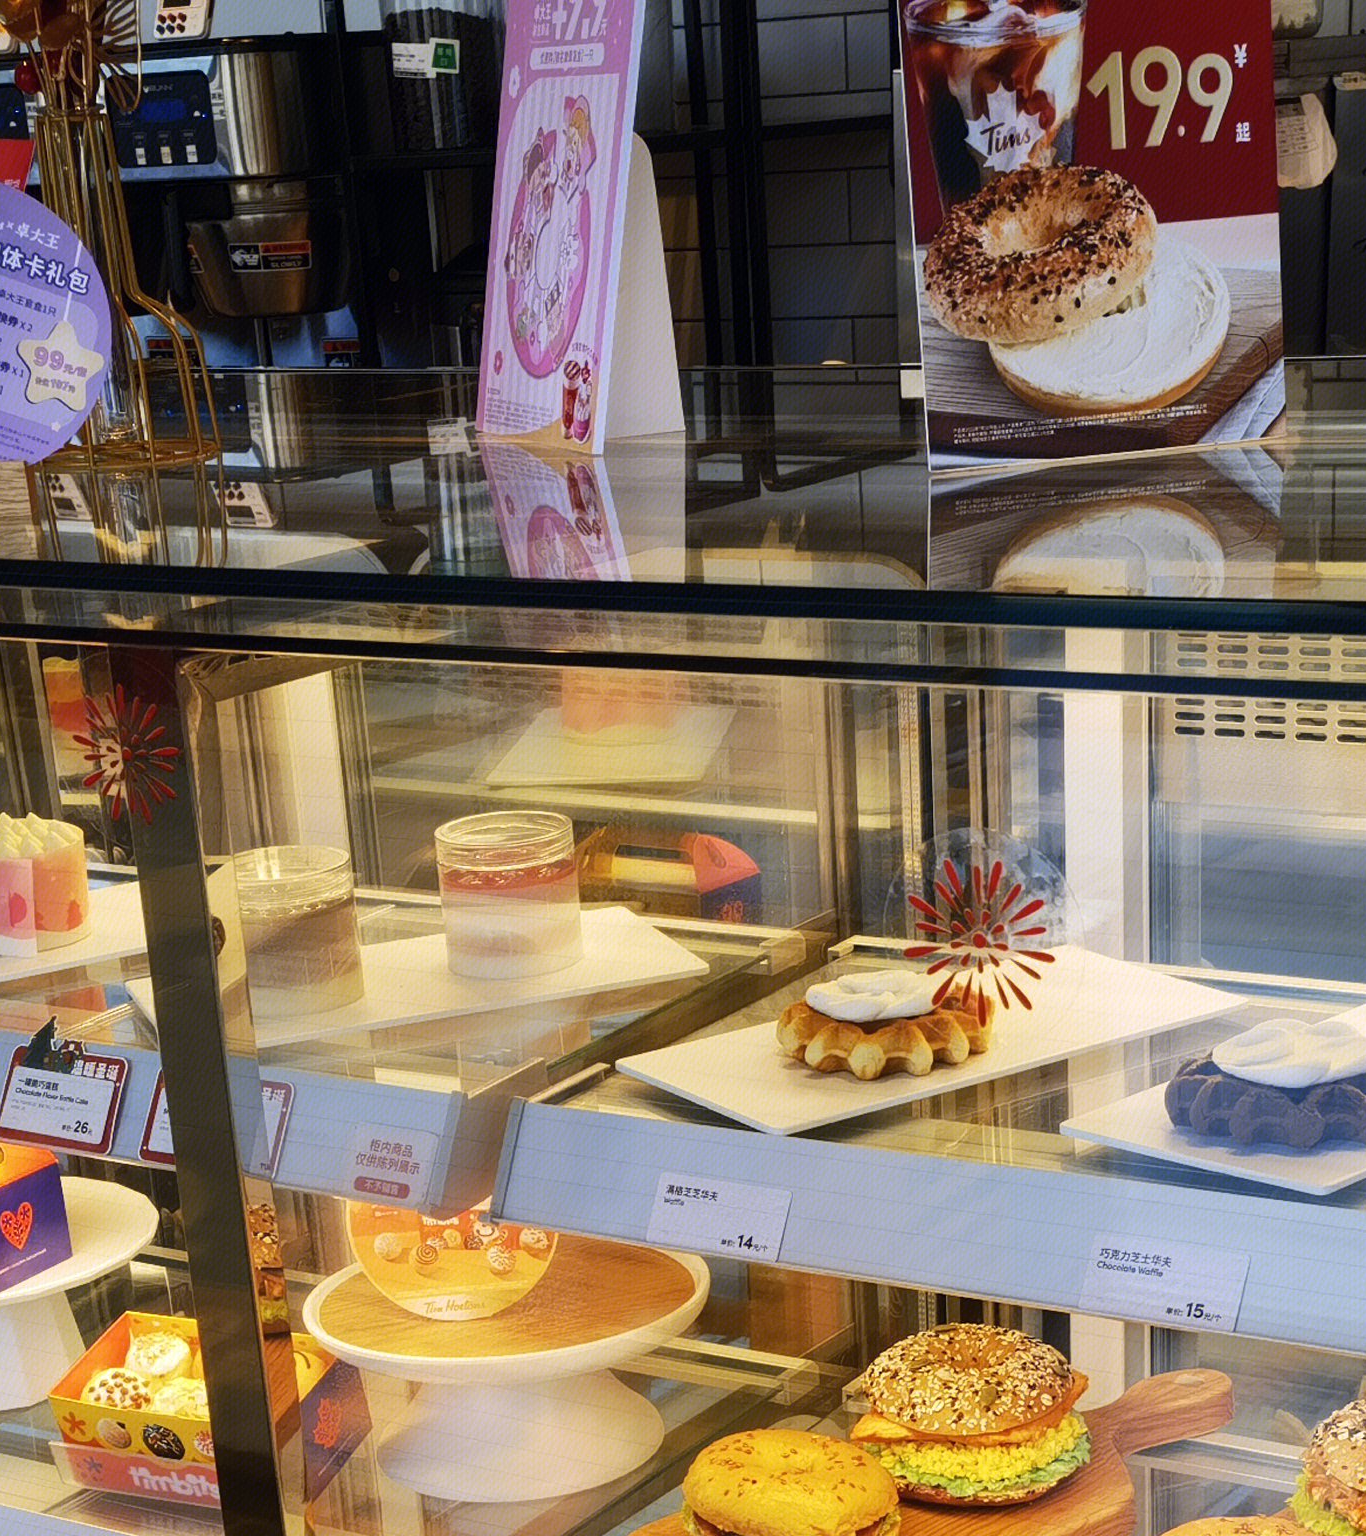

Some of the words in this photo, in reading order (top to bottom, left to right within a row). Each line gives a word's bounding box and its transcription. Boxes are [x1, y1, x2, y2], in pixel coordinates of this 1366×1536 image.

[980, 122, 1031, 156] Tims
[1236, 122, 1251, 143] 起
[370, 1138, 413, 1159] 柜内商品
[355, 1152, 420, 1176] 仅供陈列展示
[1099, 1248, 1172, 1268] 巧克力芝士华夫
[1096, 1260, 1136, 1273] Chocolate
[1138, 1267, 1164, 1278] Waffle
[423, 1301, 444, 1314] Tim
[445, 1298, 486, 1312] Hortons
[129, 1466, 220, 1499] timbits
